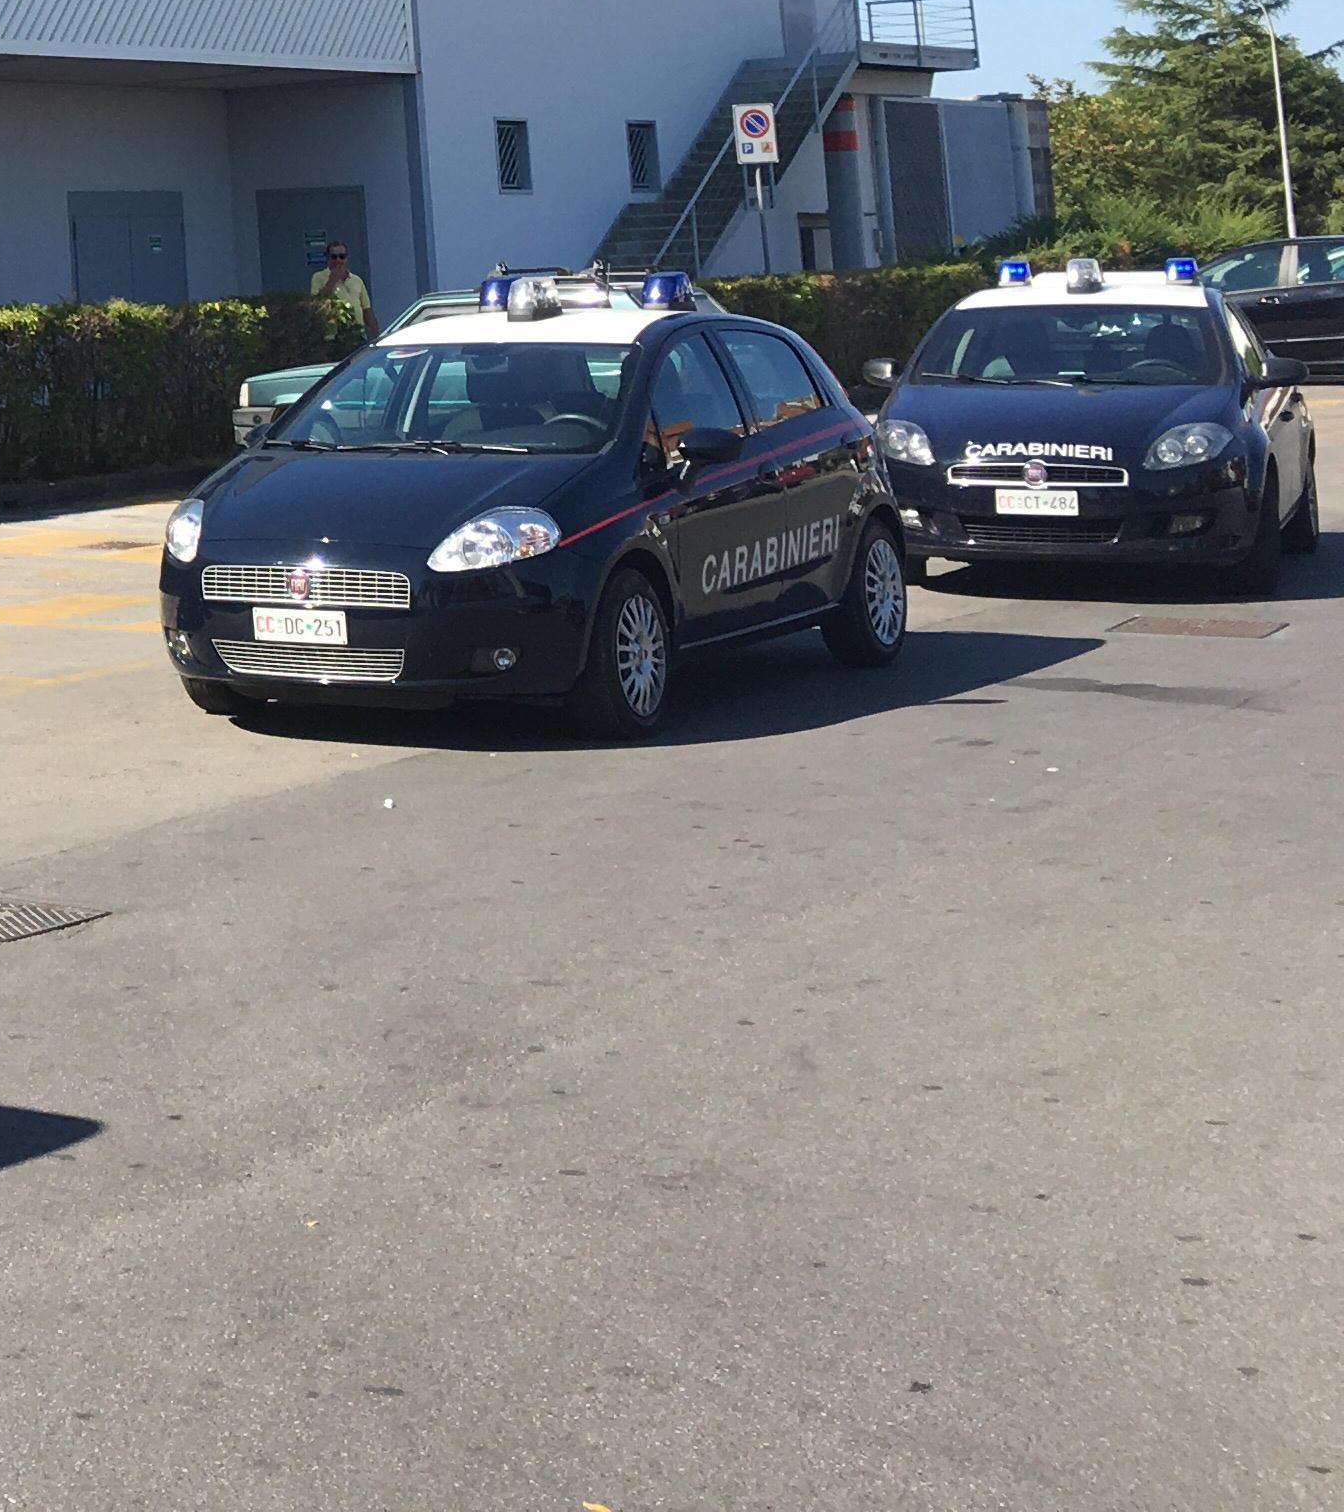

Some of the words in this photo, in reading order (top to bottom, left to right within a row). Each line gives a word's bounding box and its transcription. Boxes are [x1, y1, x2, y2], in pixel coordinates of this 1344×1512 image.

[964, 441, 1113, 461] CARABINIERI
[702, 514, 840, 595] CARABINIERI
[313, 618, 342, 637] 251
